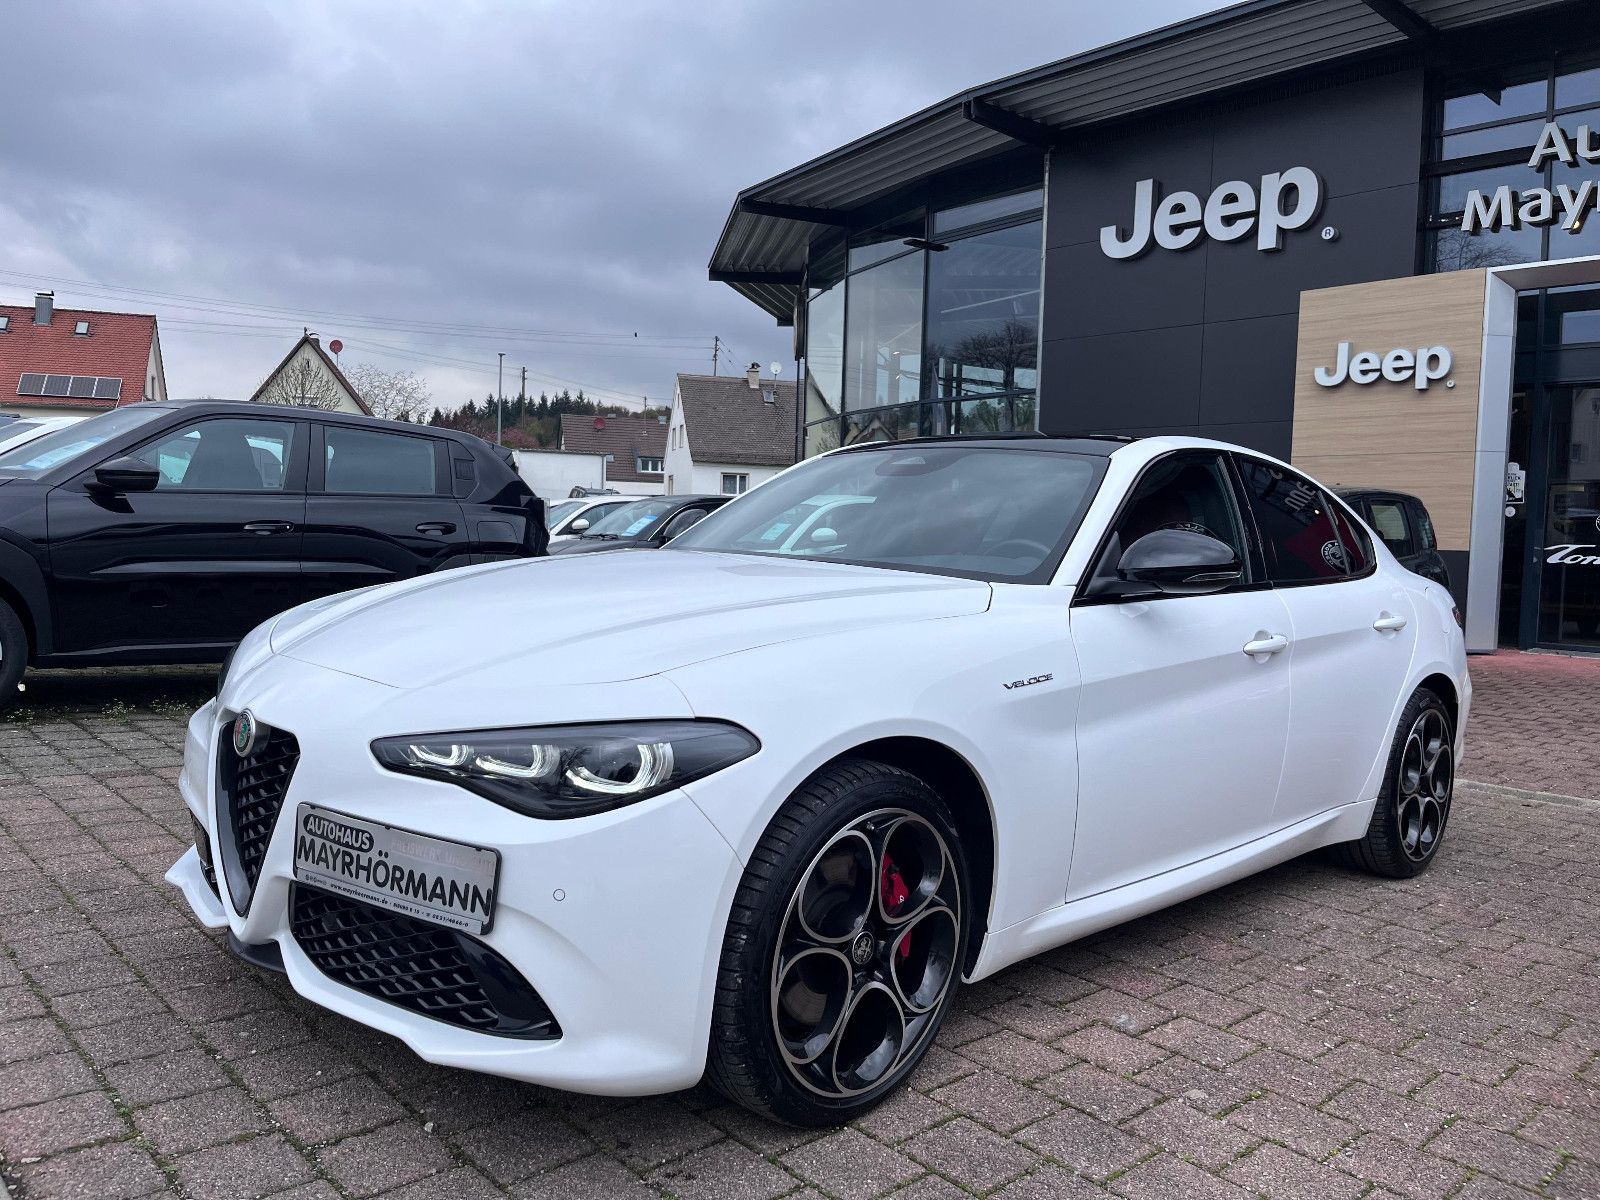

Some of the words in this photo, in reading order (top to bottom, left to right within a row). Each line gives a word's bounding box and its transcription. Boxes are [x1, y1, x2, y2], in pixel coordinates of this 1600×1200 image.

[1100, 166, 1321, 260] Jeep
[1461, 181, 1600, 231] May
[1314, 342, 1452, 389] Jeep
[1002, 672, 1054, 690] VELOCE
[306, 816, 371, 851] AUTOHAUS
[297, 835, 493, 917] MAYRHÖRMANN
